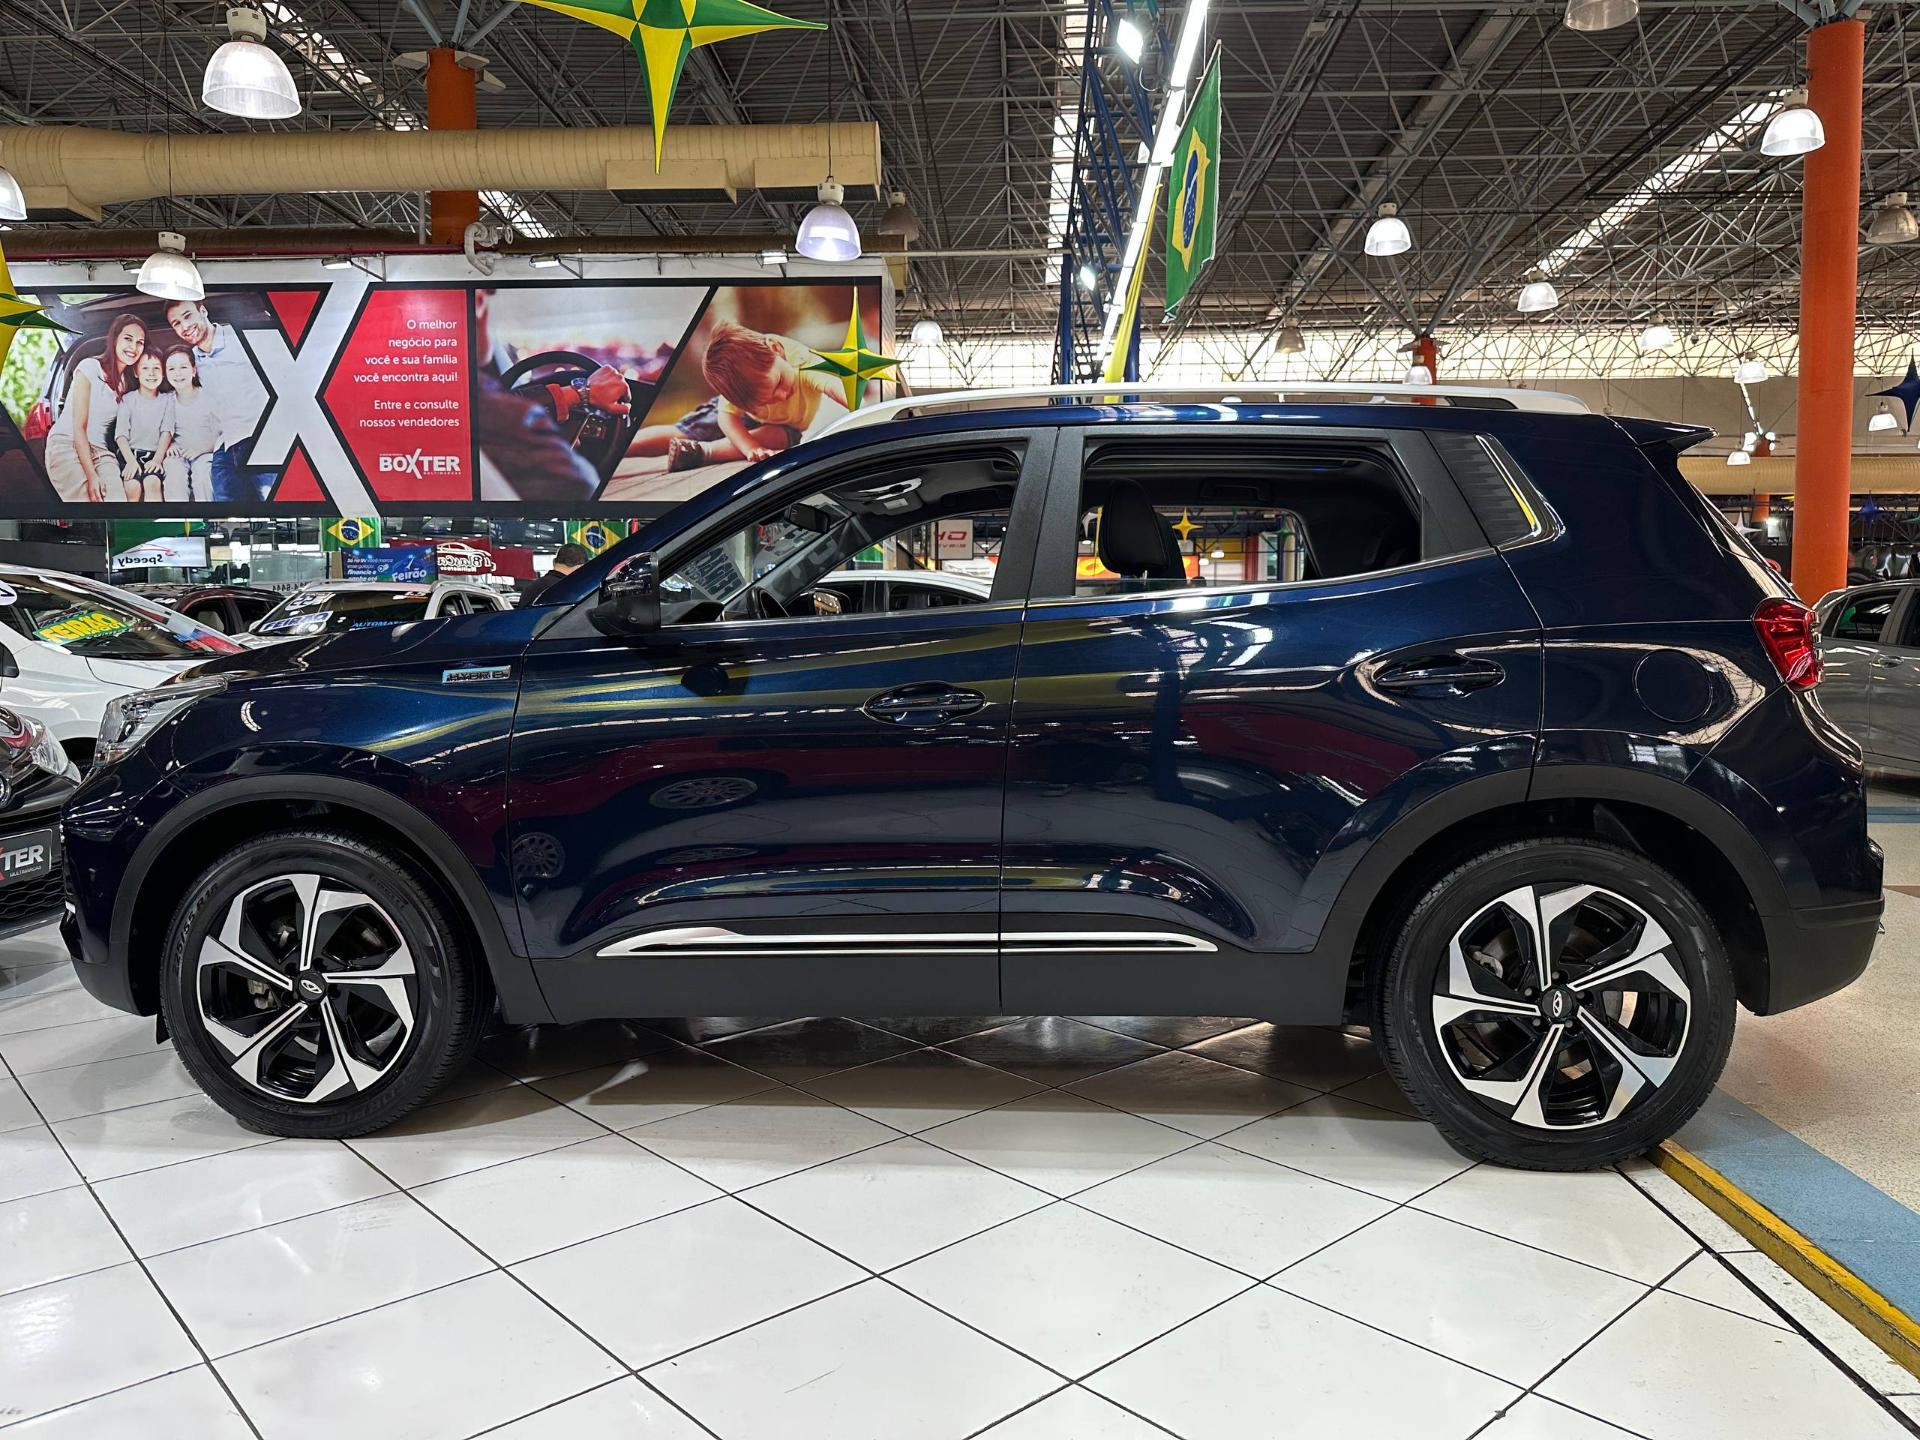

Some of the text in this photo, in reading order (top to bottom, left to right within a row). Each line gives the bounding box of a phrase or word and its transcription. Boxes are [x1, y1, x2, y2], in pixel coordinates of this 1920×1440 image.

[406, 319, 458, 330] O melhor
[388, 337, 458, 350] negócio para
[364, 354, 390, 365] você
[422, 354, 458, 365] família
[354, 372, 458, 384] você encontra aqui!
[374, 400, 402, 410] Entre
[414, 400, 460, 410] consulte
[359, 417, 460, 427] nossos vendedores
[379, 448, 461, 479] BOXTER
[392, 568, 427, 582] Feirão
